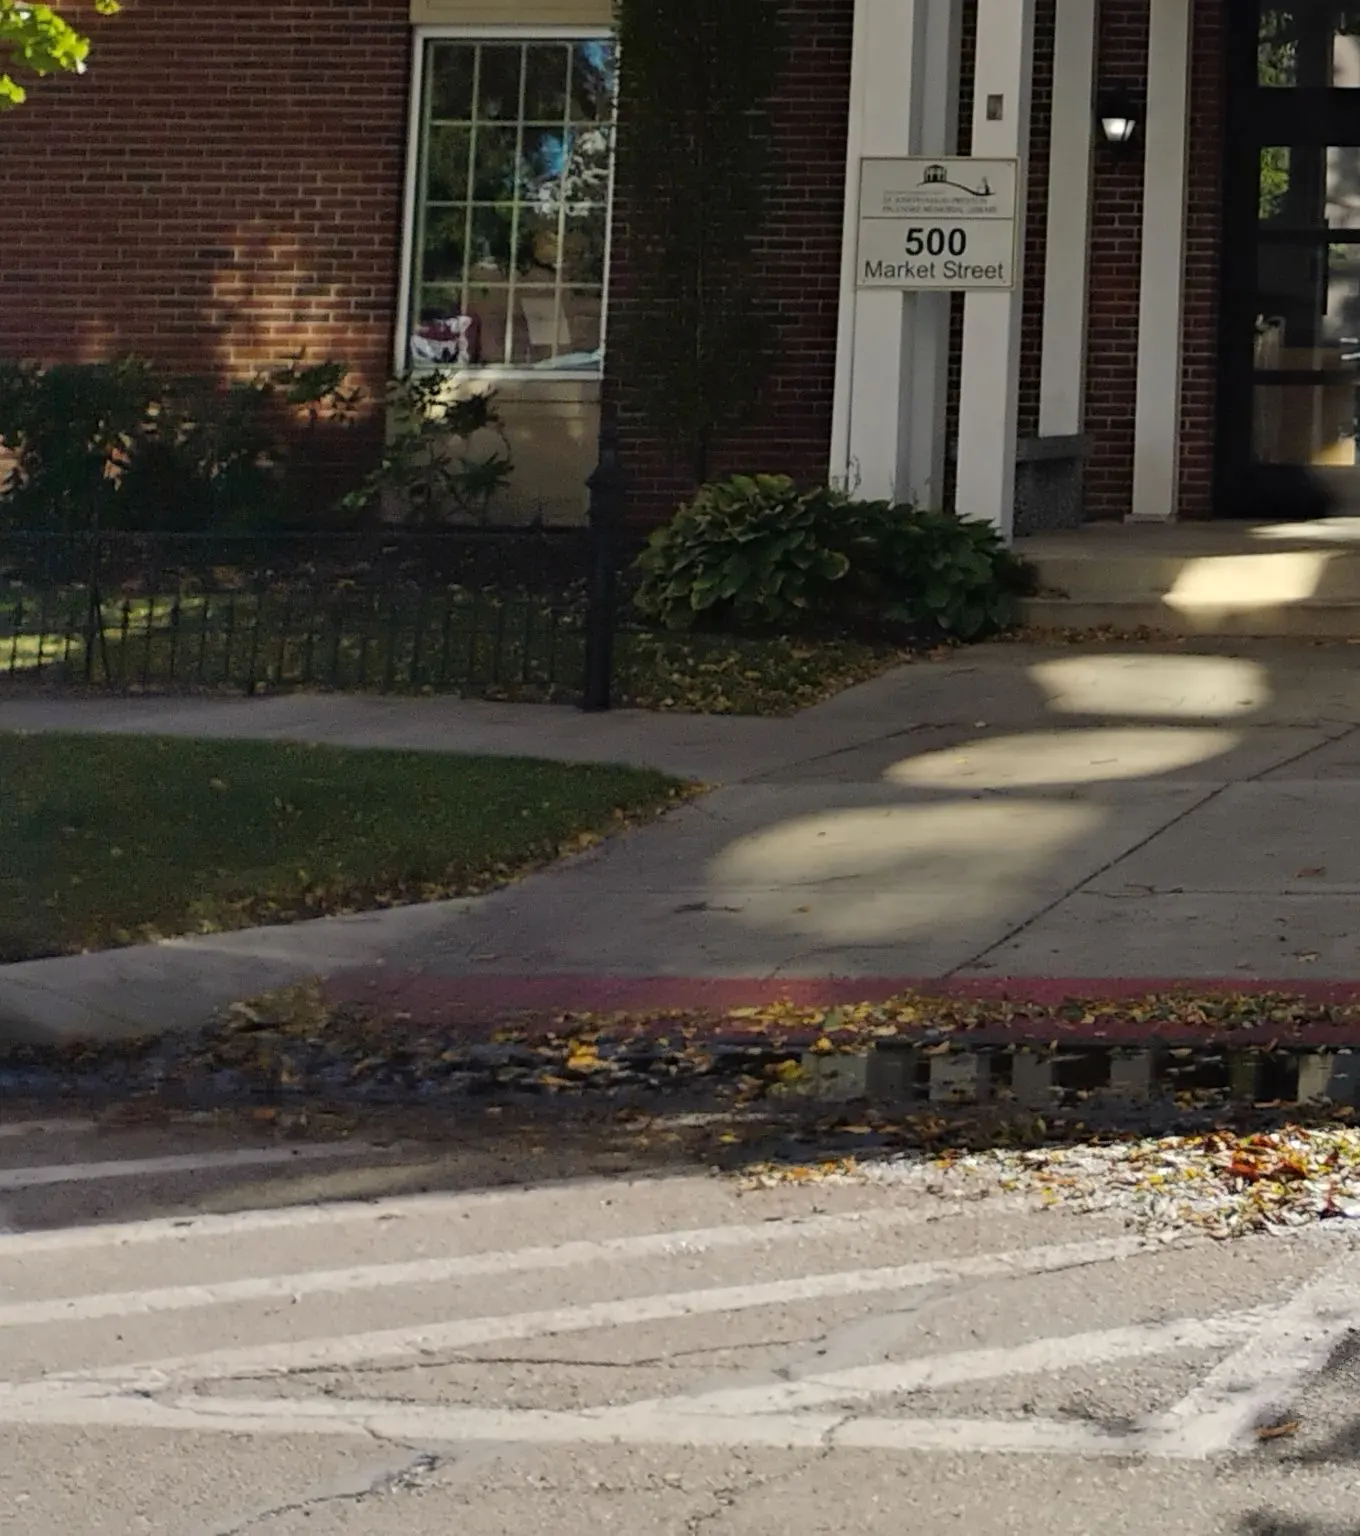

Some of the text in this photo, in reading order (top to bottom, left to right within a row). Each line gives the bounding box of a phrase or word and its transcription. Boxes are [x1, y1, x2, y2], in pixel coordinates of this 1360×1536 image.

[905, 227, 967, 256] 500
[864, 260, 1004, 279] Market Street
